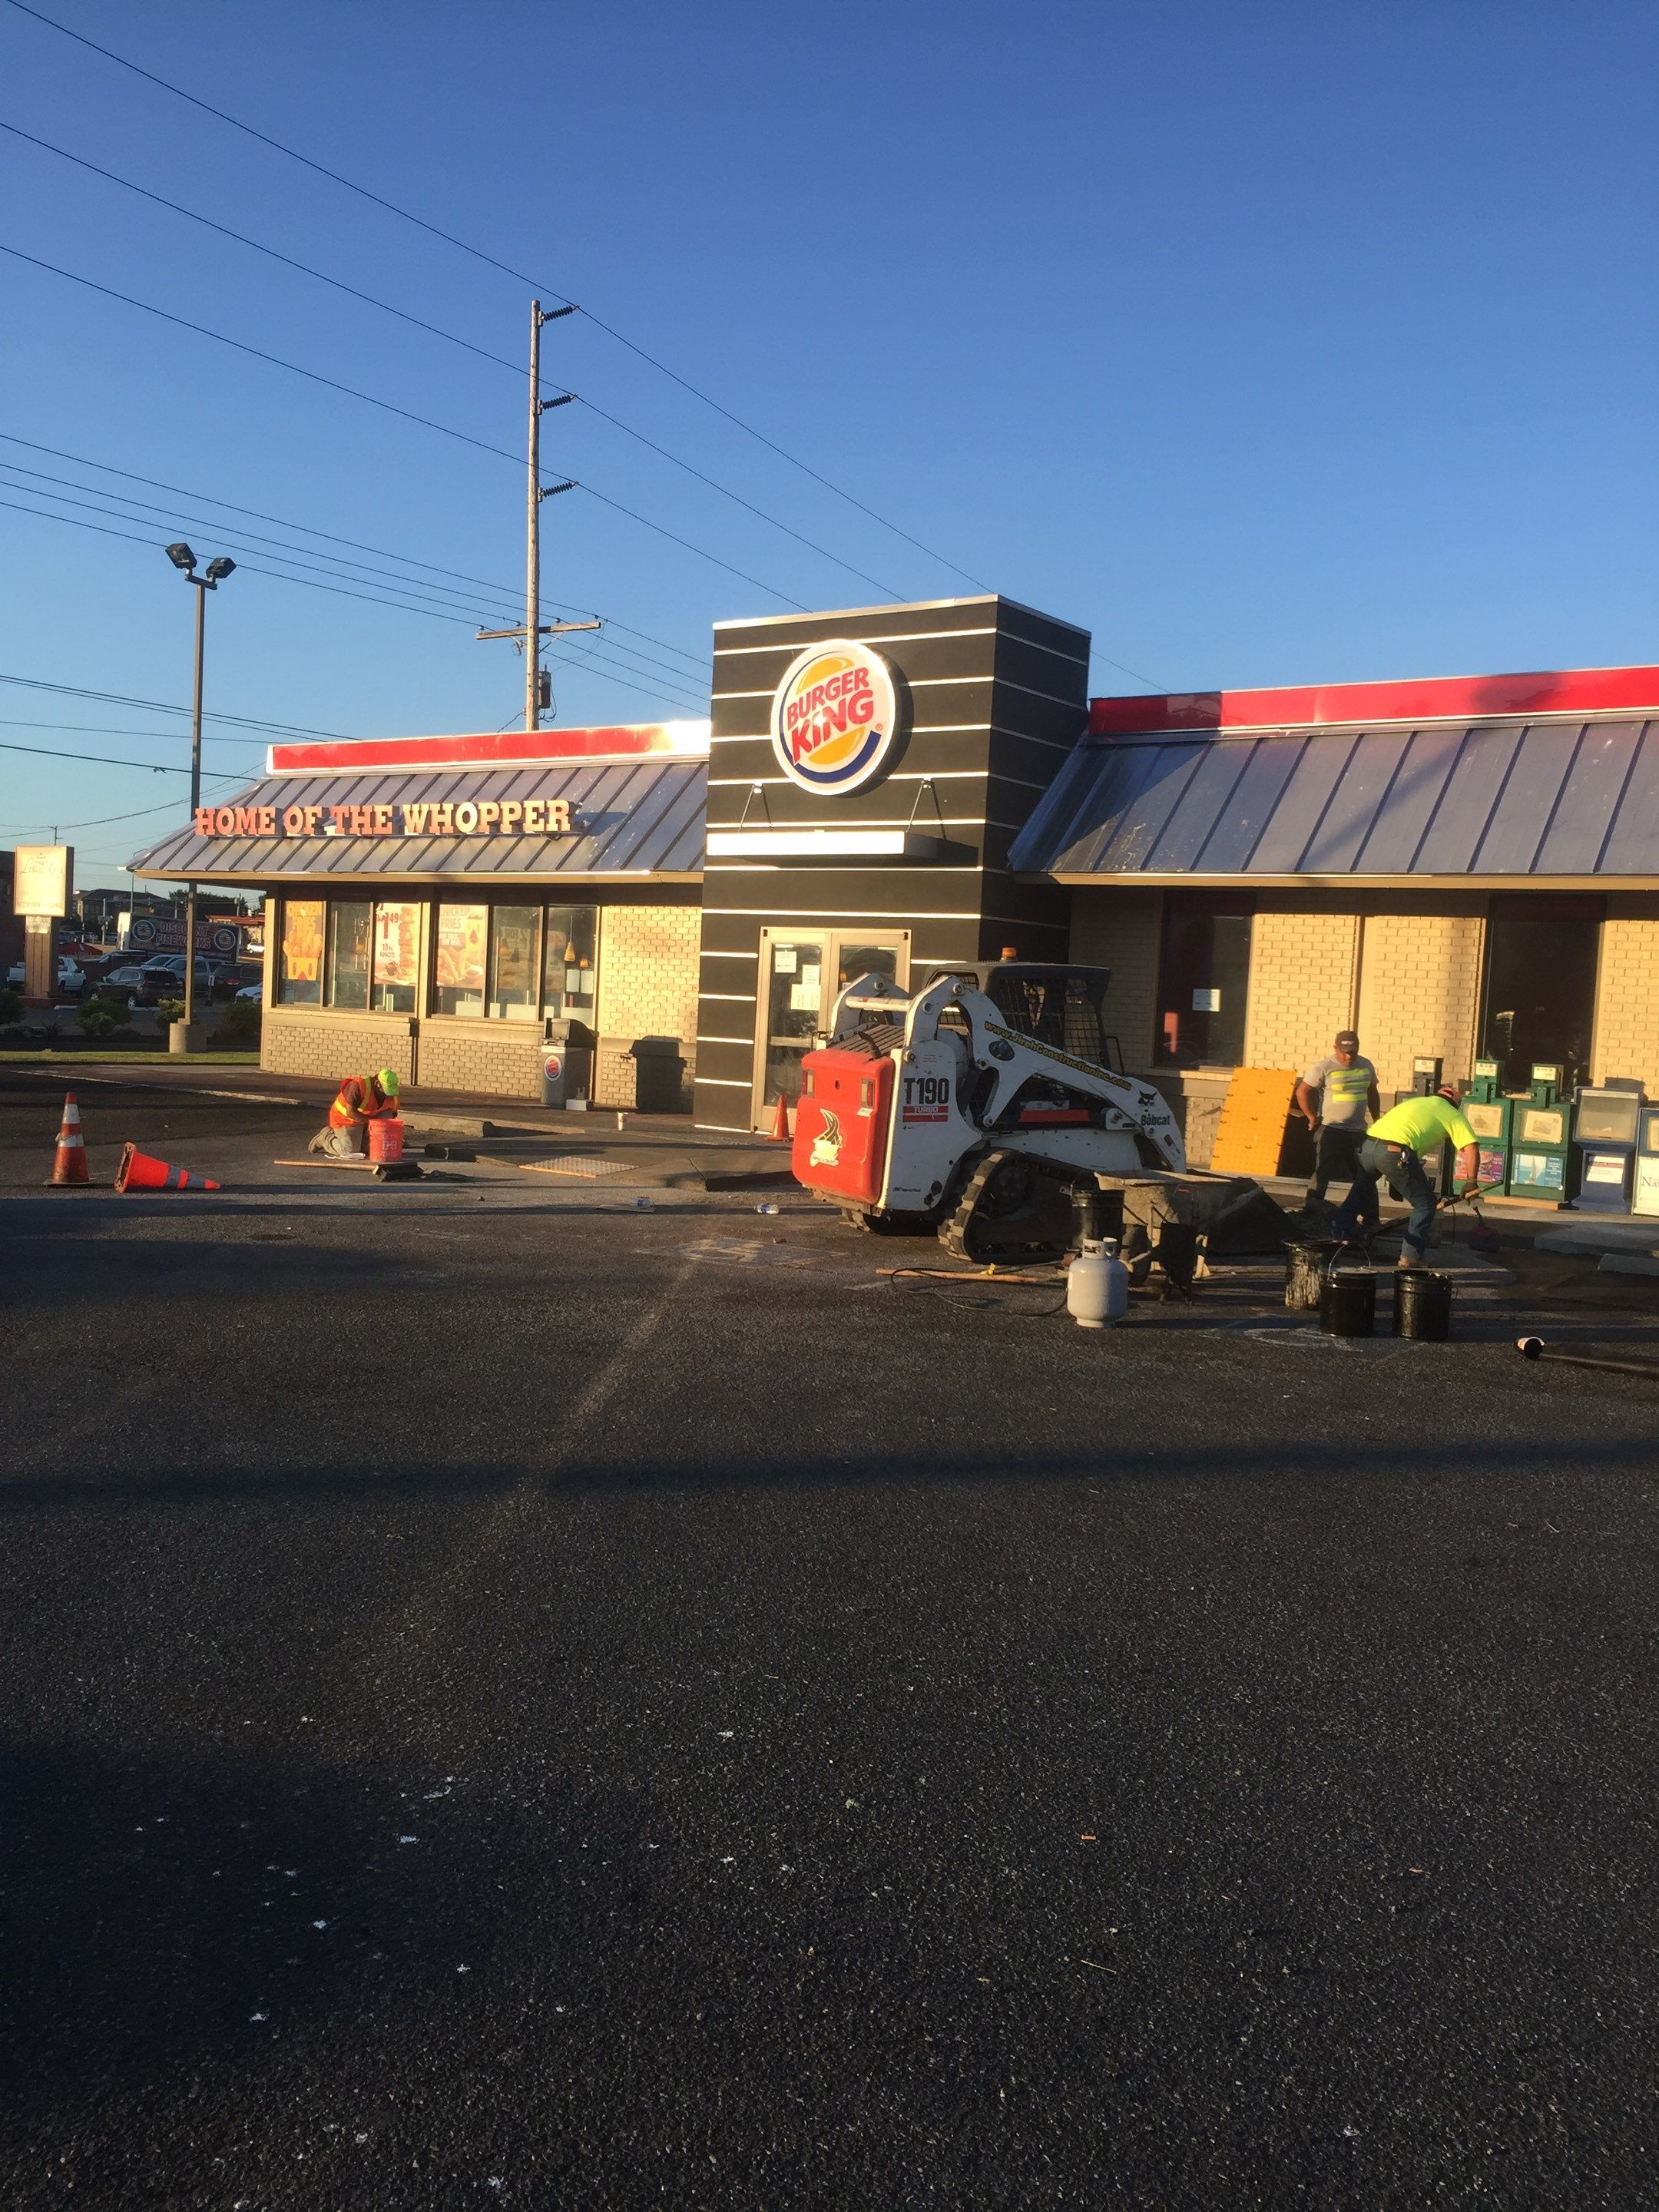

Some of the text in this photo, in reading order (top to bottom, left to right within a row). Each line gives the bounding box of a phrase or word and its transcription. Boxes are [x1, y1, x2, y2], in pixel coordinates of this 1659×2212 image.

[787, 667, 869, 730] BURGER
[791, 690, 874, 763] KING
[195, 800, 571, 836] HOME OF THE WHOPPER
[441, 906, 470, 917] CHICKEN
[160, 922, 210, 935] DISCONT
[293, 917, 316, 930] FRIES
[441, 918, 461, 929] FRIES
[903, 1078, 949, 1104] T190
[1141, 1114, 1171, 1126] Bobcat
